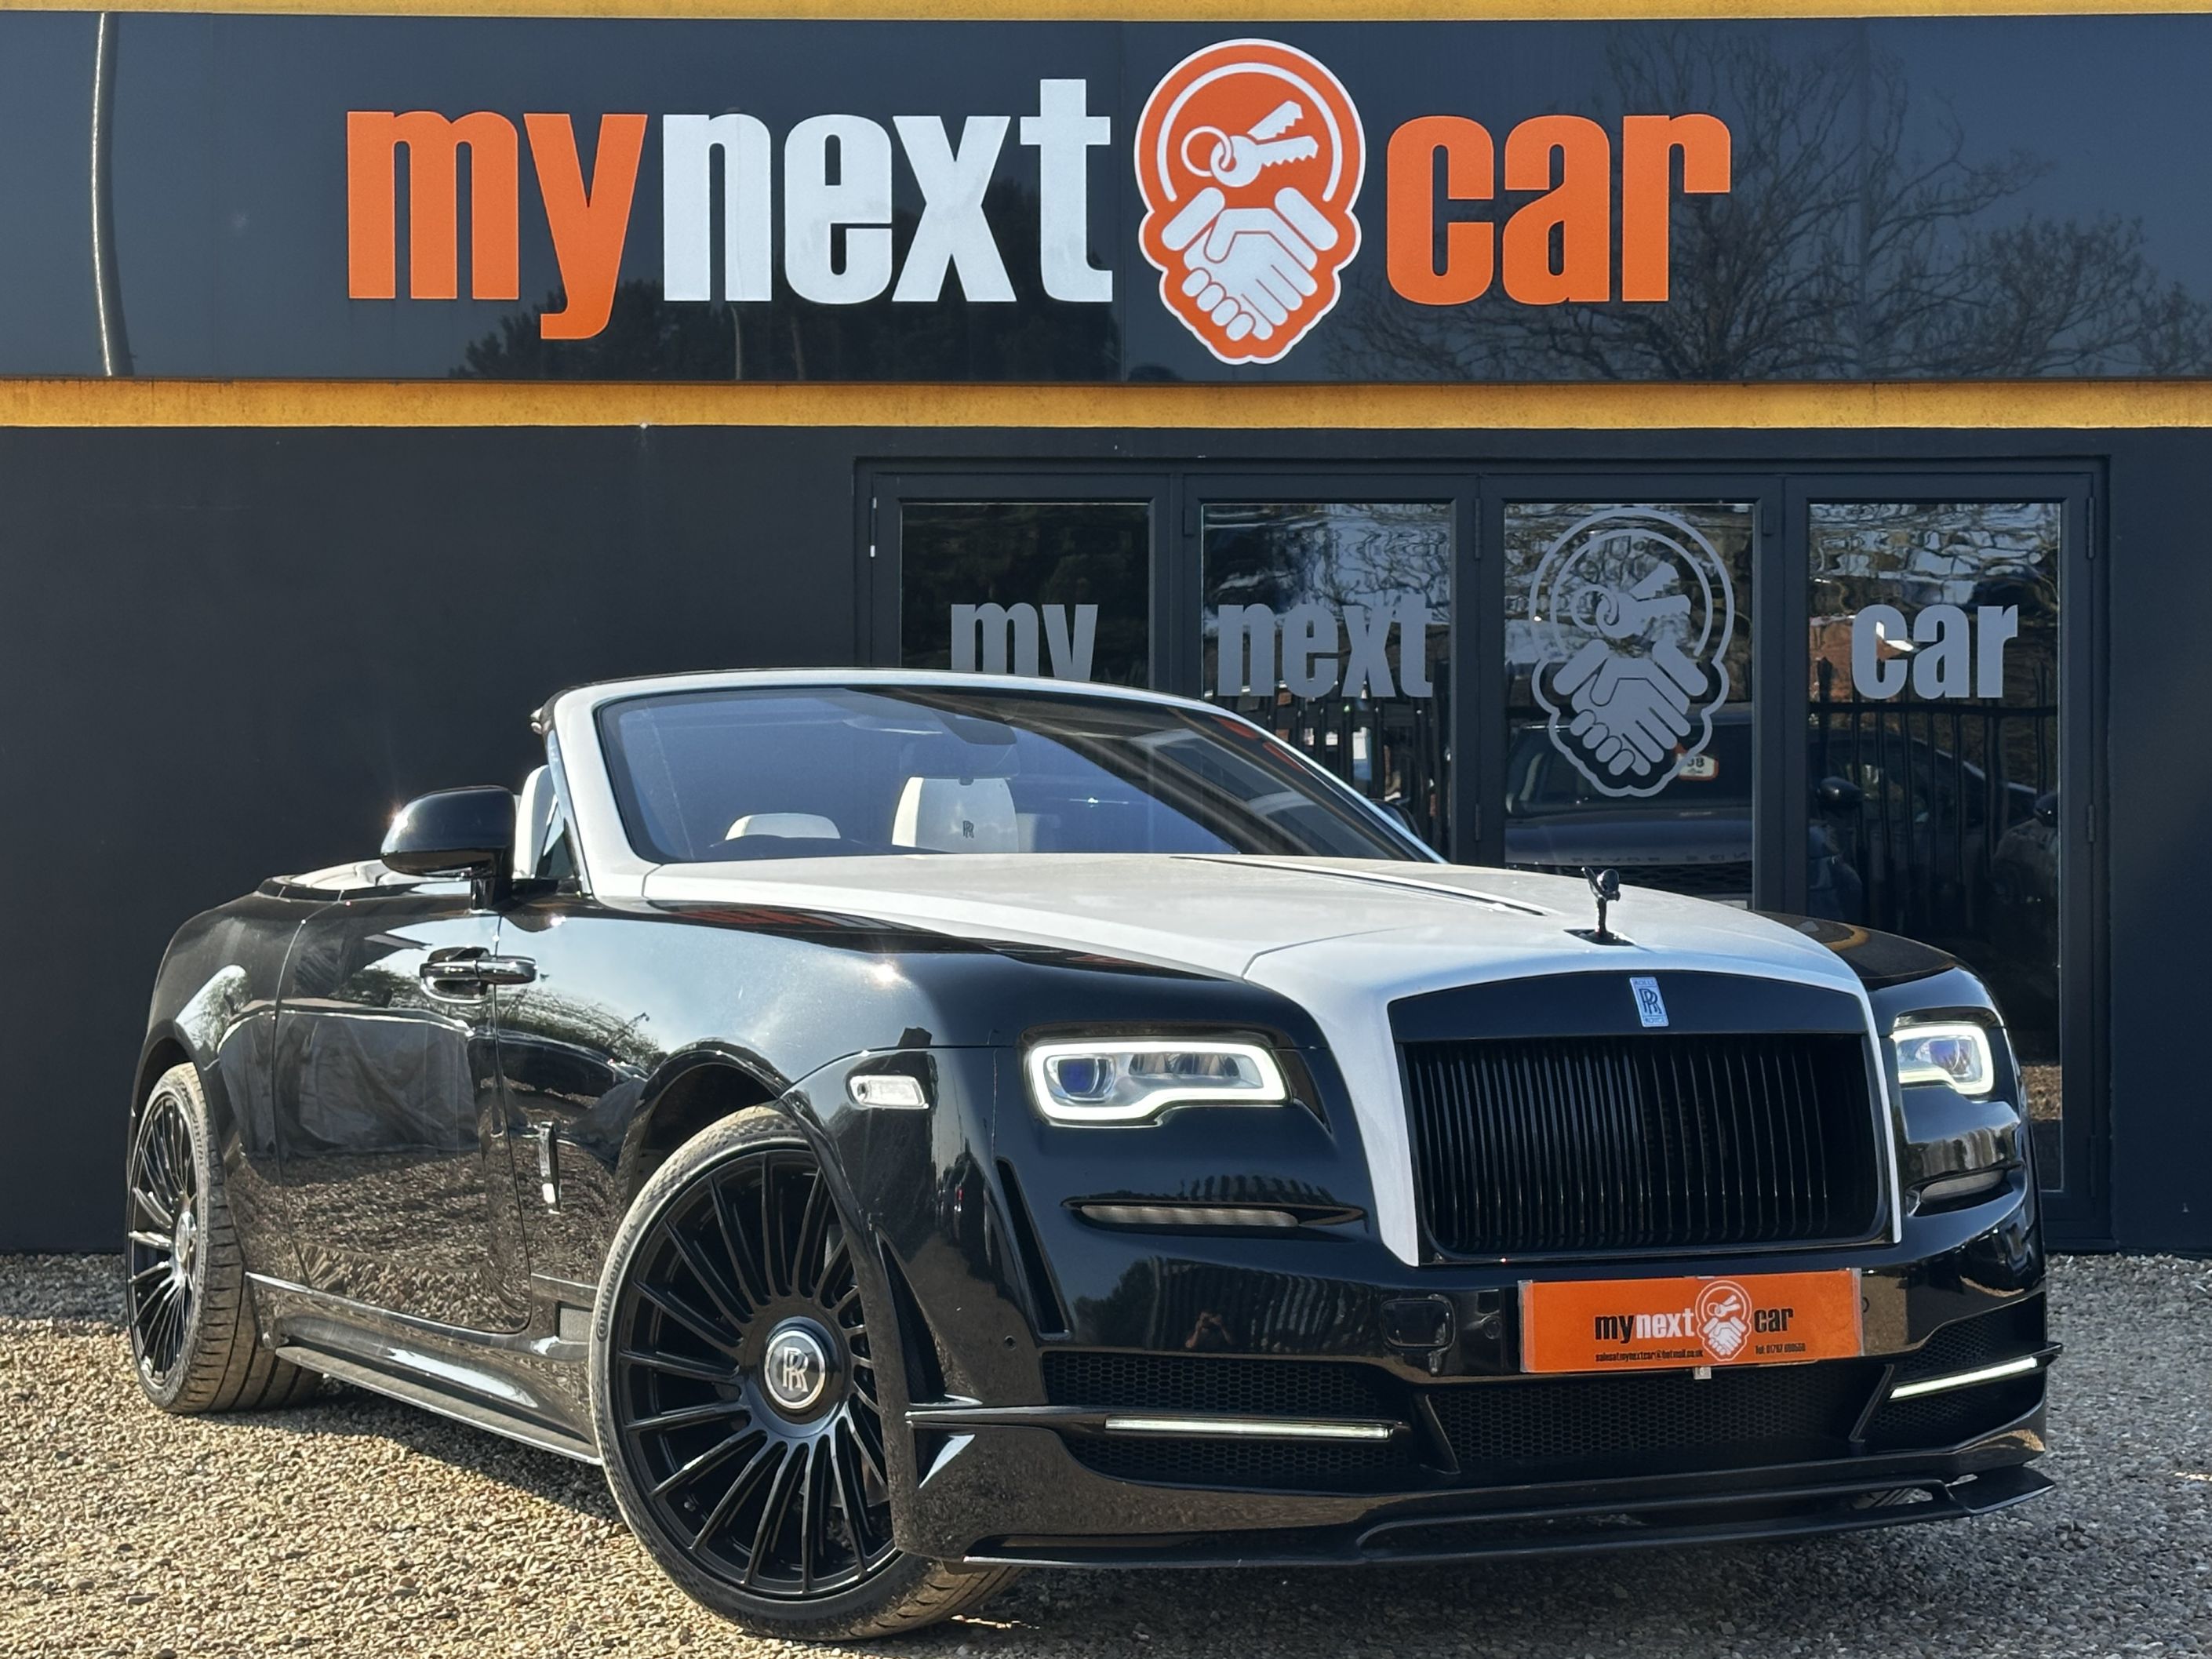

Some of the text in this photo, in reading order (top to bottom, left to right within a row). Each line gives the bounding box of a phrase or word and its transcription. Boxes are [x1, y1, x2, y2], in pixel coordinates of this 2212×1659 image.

[1387, 113, 1731, 305] car
[1218, 594, 1433, 698] next
[1852, 604, 2018, 700] car
[596, 1234, 632, 1342] Continental
[1753, 1308, 1793, 1333] car
